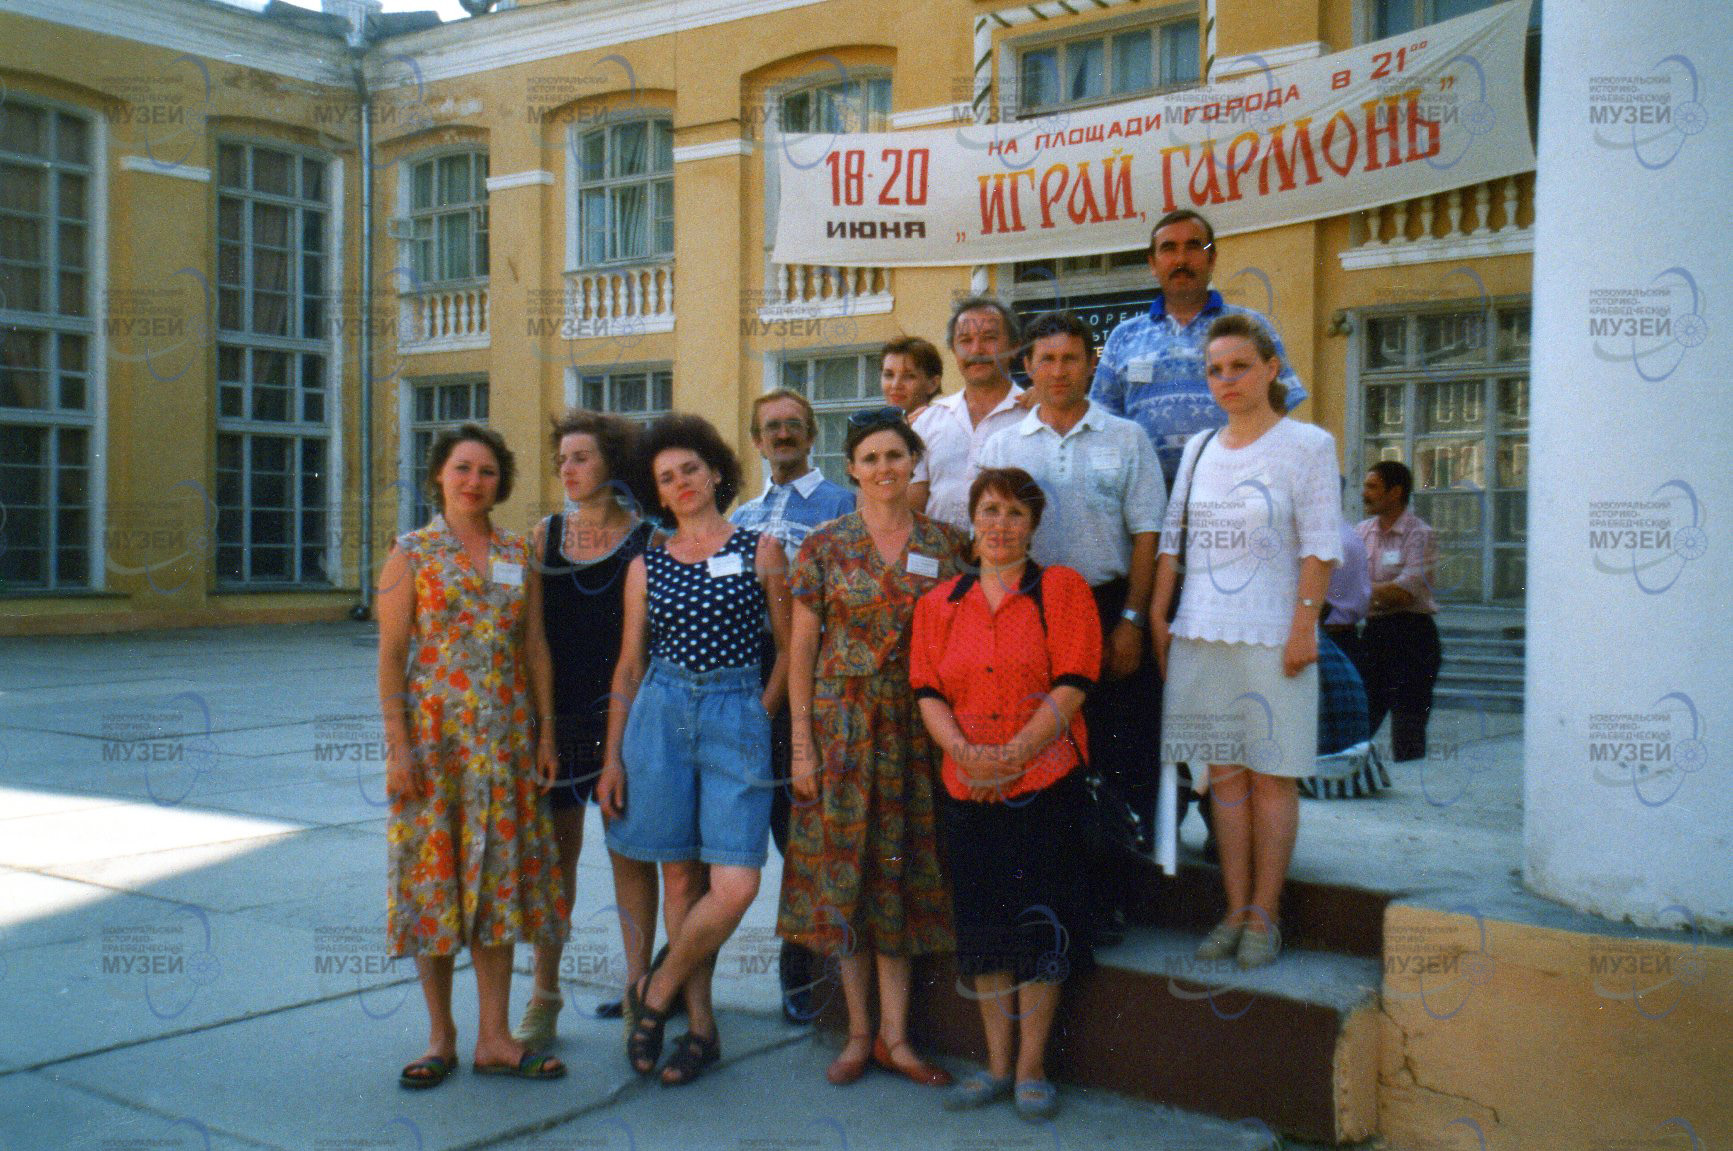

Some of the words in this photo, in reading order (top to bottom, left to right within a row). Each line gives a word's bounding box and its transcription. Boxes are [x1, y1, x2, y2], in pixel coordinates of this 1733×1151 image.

[988, 138, 1018, 156] НА
[1035, 113, 1161, 151] ПЛОЩАДИ
[1183, 84, 1299, 125] ГОРОДА
[1331, 69, 1351, 90] В
[826, 221, 927, 239] ИЮНЯ
